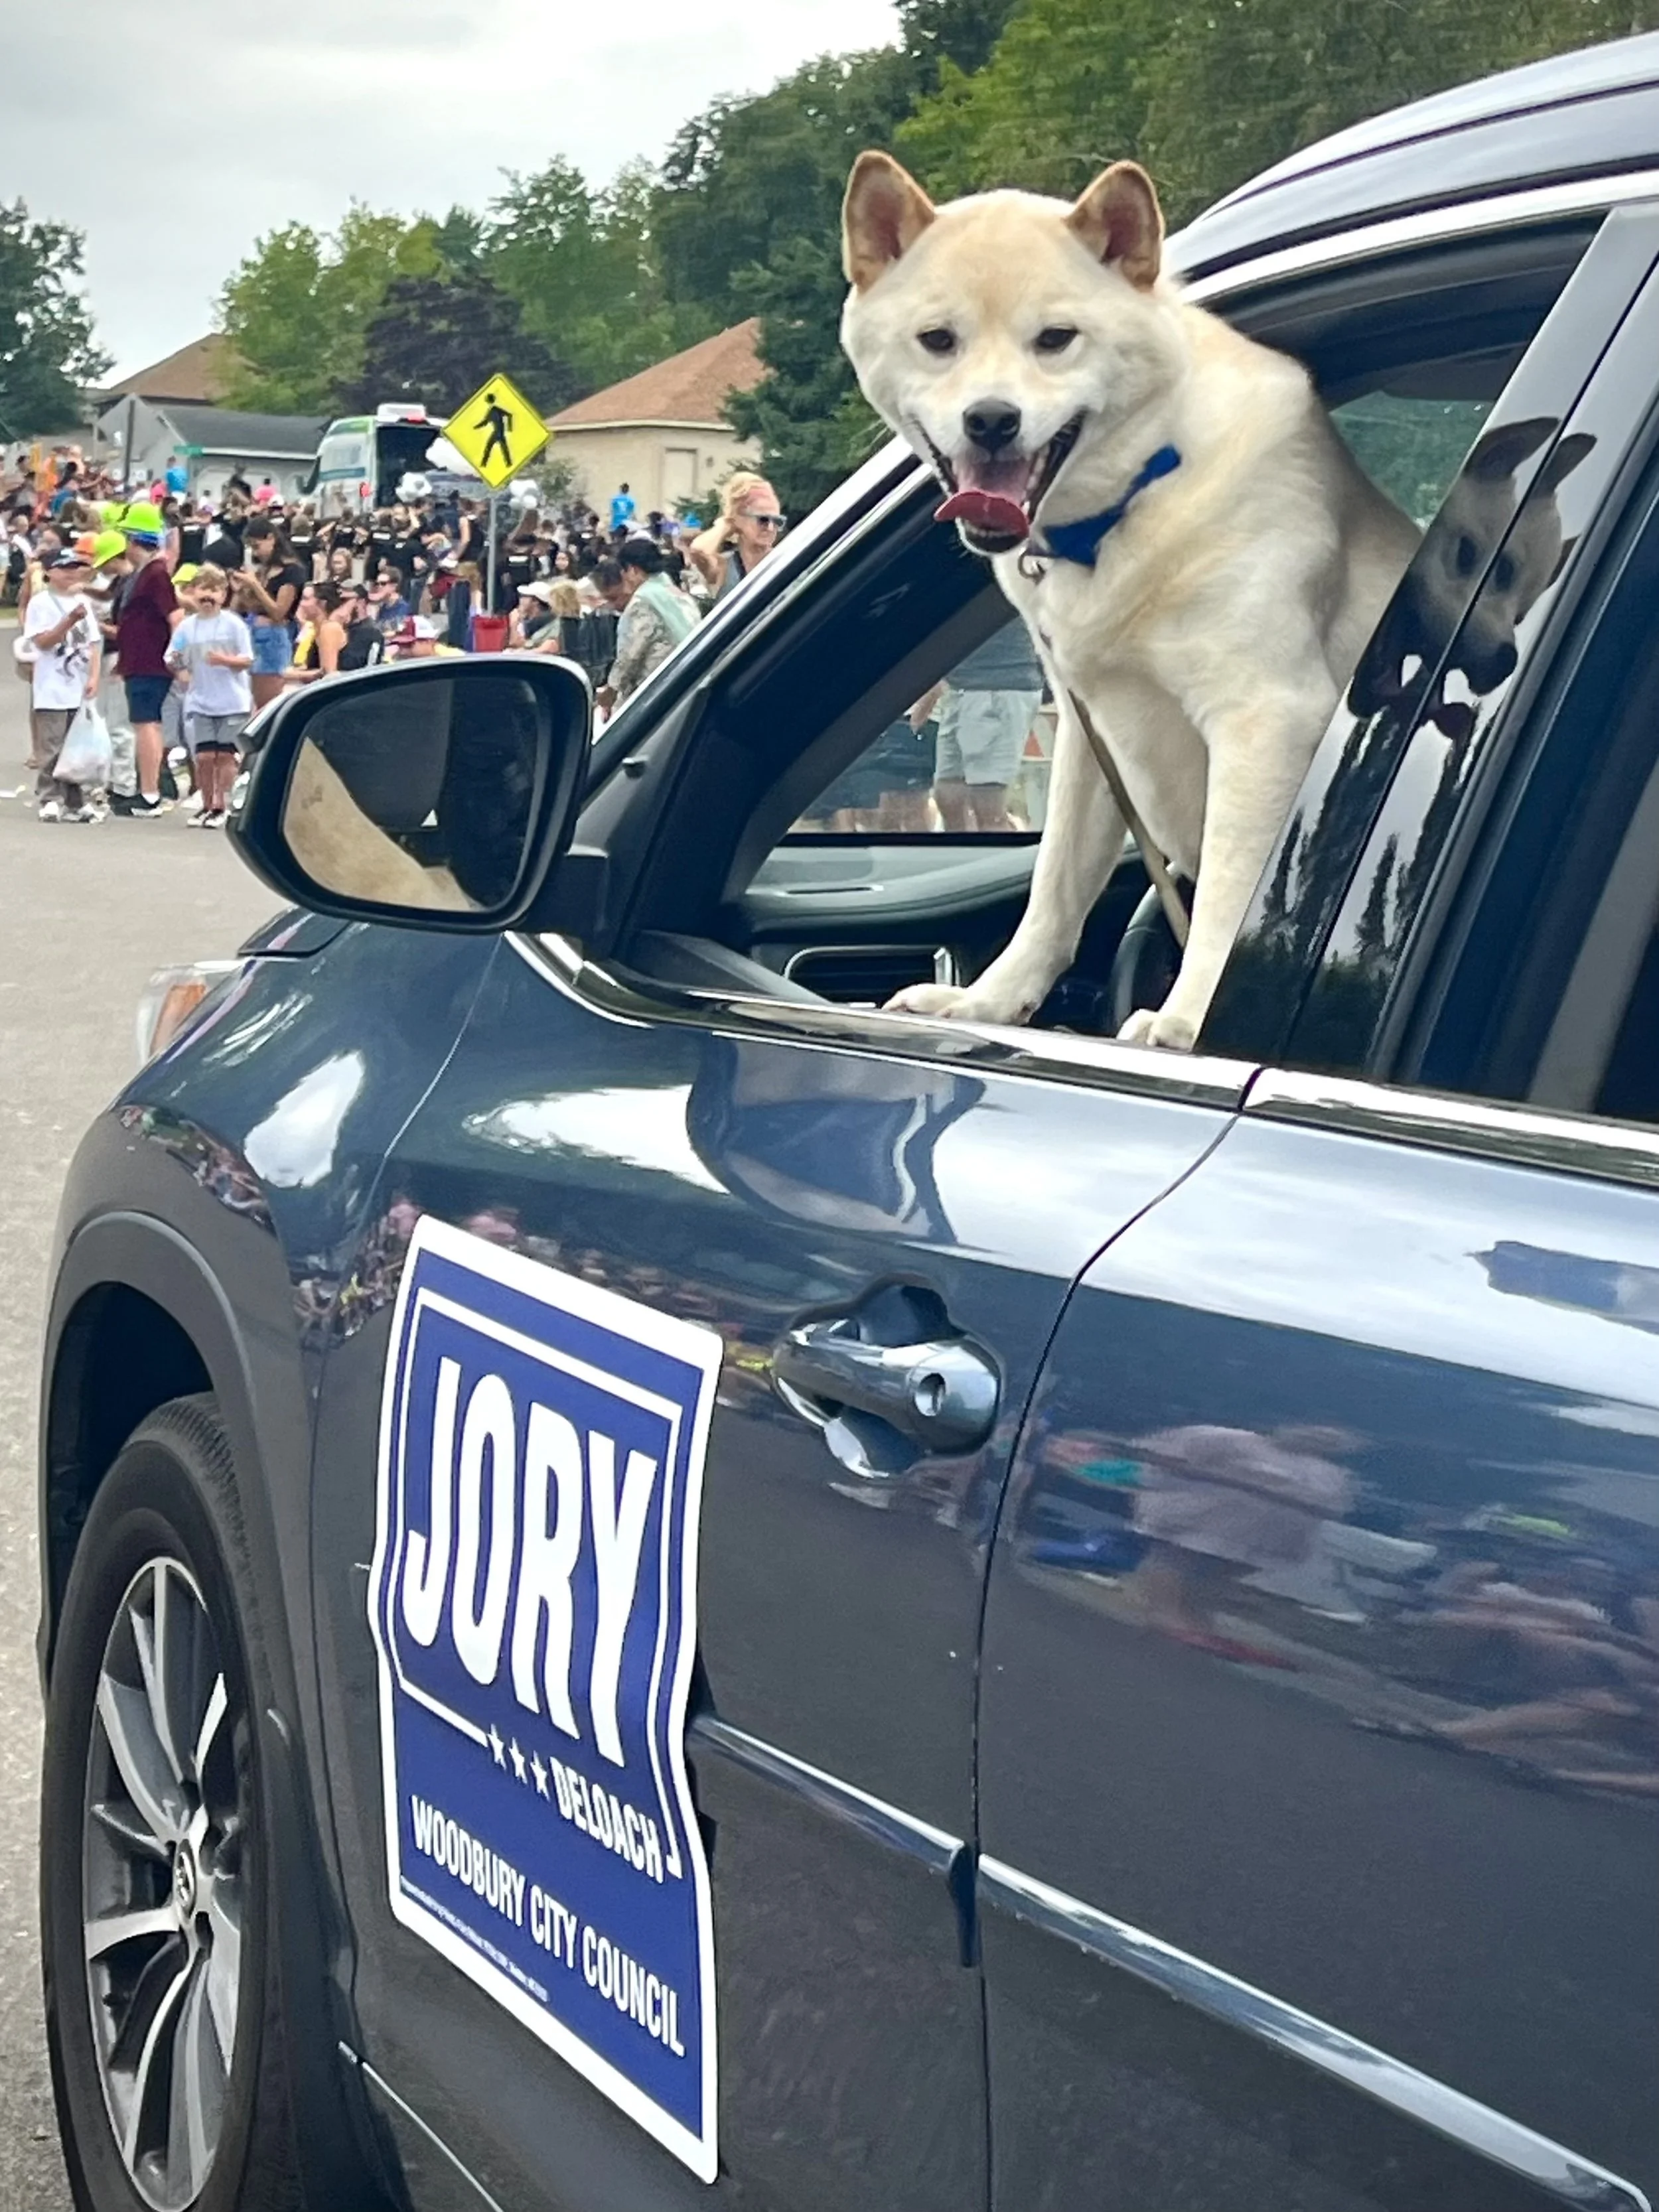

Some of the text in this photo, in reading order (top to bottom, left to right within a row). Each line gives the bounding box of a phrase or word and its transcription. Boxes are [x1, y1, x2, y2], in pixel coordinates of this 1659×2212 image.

[402, 1356, 658, 1767] JORY
[411, 1795, 526, 1927] WOODBURY
[530, 1884, 577, 1969] CITY
[583, 1925, 685, 2057] COUNCIL
[549, 1756, 664, 1884] DELOACH
